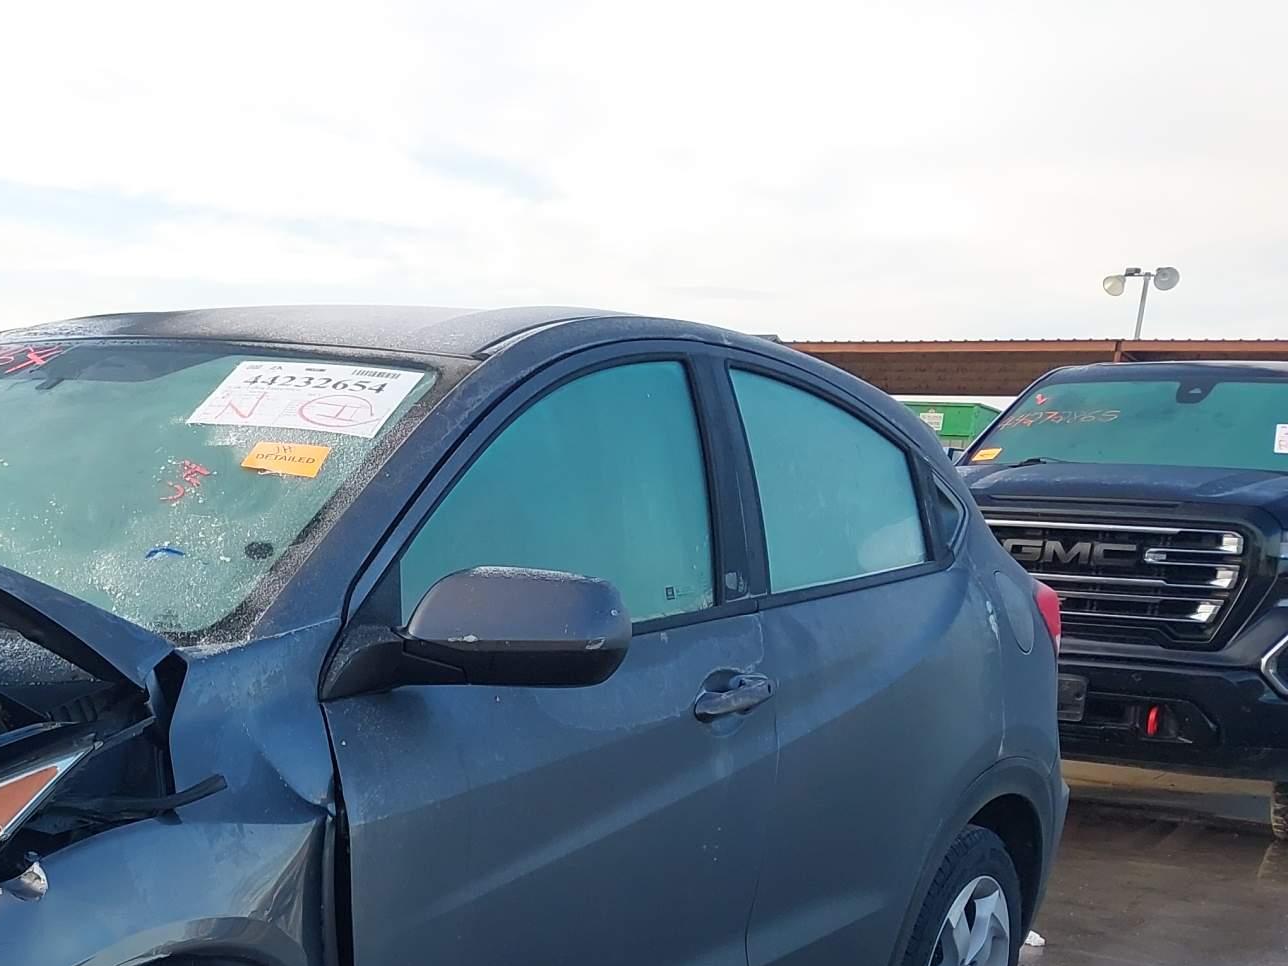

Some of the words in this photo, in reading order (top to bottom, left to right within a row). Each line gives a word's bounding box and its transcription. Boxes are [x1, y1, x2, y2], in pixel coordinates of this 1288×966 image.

[243, 374, 388, 394] 44232654
[255, 453, 316, 464] DETAILED
[1004, 539, 1136, 565] GMC
